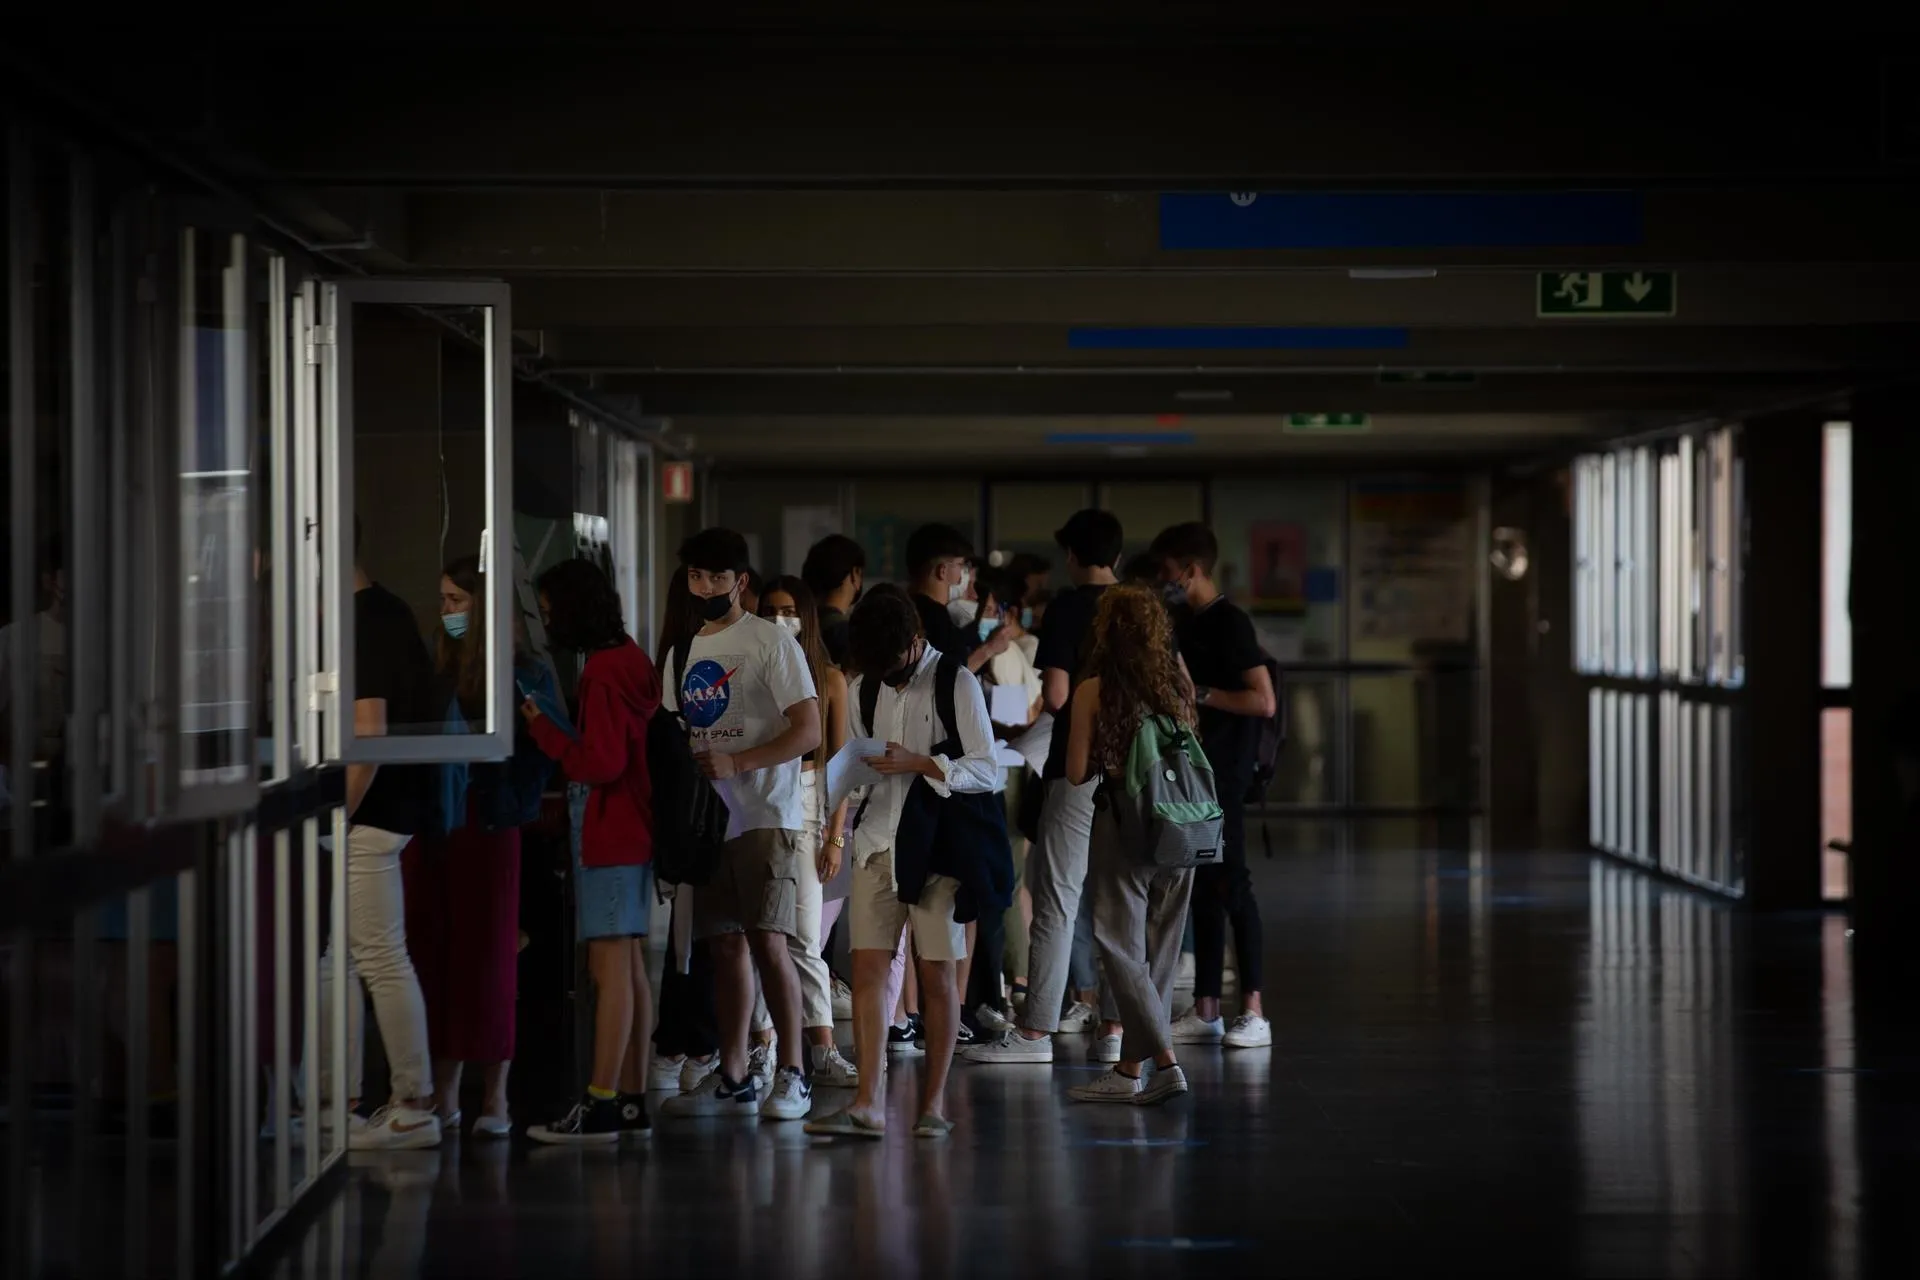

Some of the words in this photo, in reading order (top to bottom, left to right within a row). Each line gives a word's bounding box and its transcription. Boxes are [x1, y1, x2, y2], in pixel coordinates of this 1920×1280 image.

[684, 686, 728, 702] NASA
[692, 730, 708, 740] MY
[711, 729, 744, 739] SPACE
